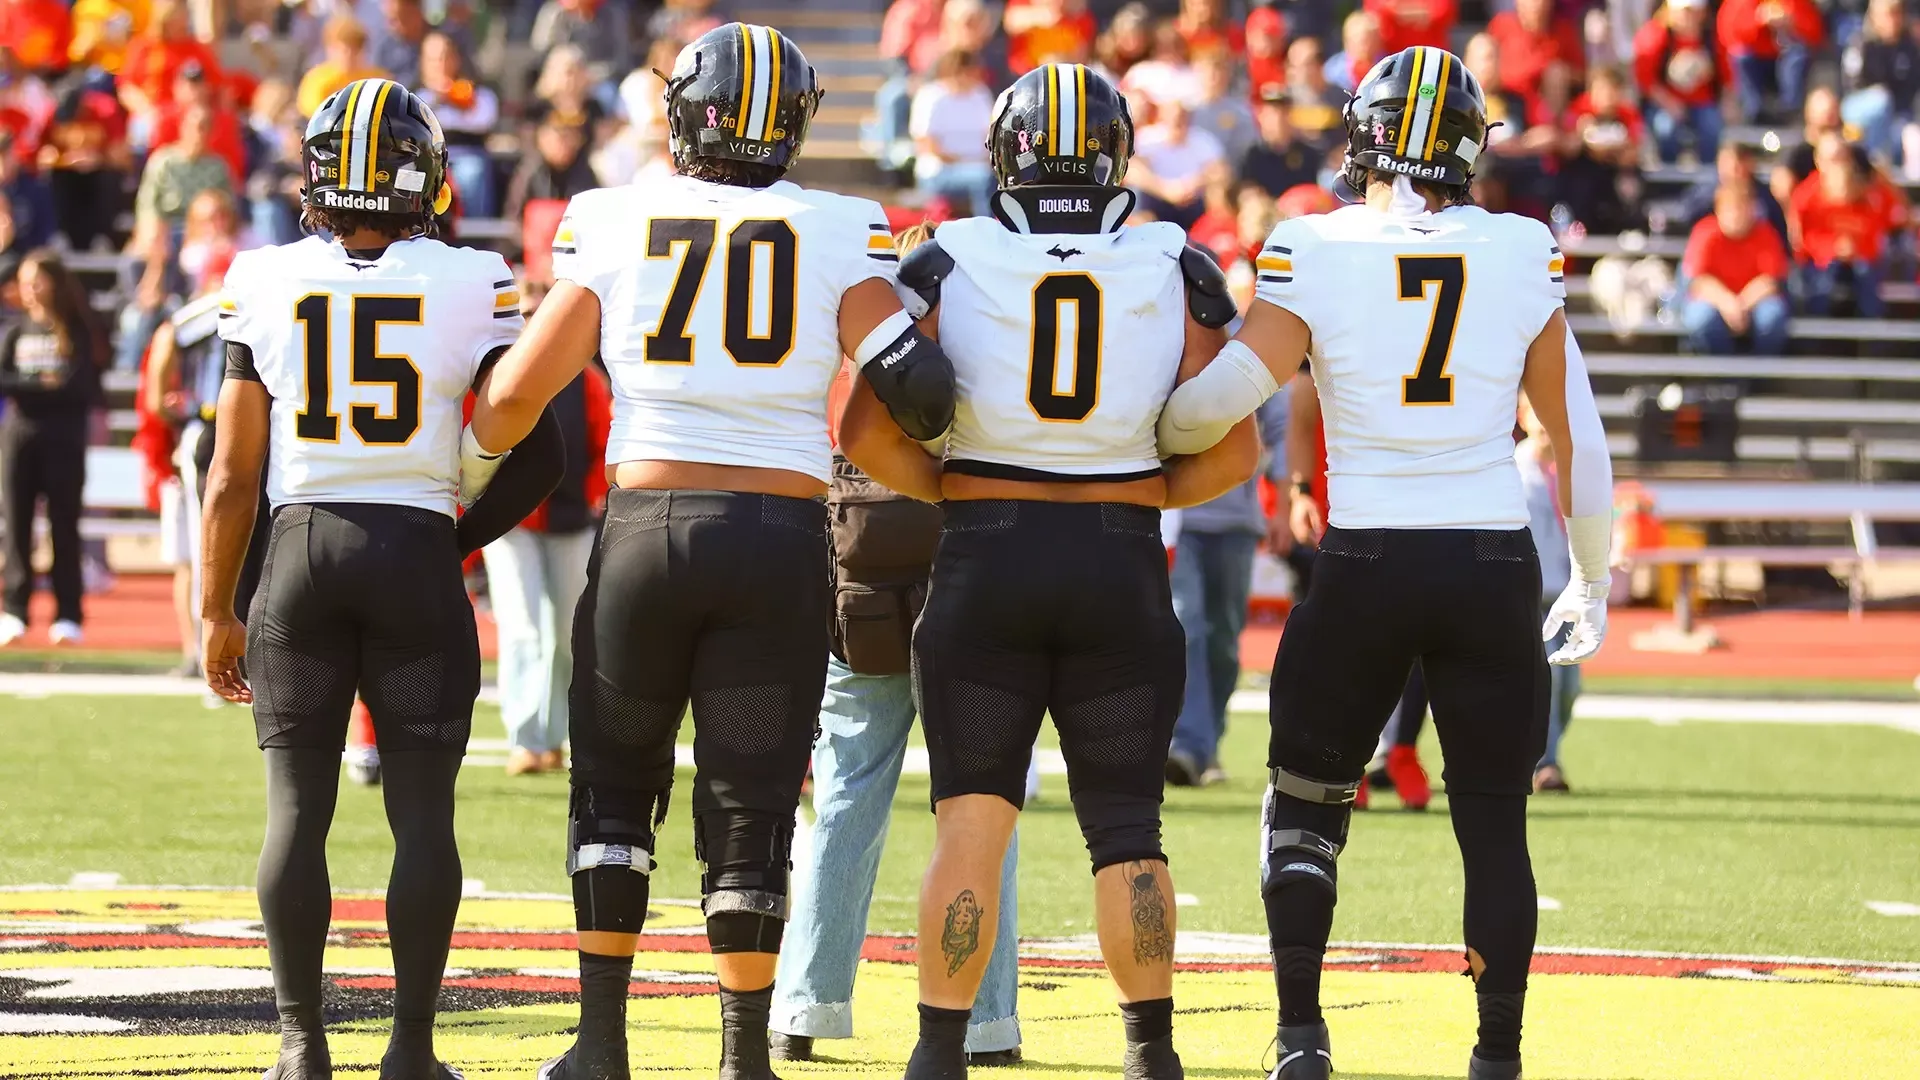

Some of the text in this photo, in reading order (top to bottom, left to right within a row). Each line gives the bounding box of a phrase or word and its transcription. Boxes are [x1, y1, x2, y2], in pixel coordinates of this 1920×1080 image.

[1419, 87, 1435, 95] C2P
[1388, 130, 1395, 141] 7
[729, 142, 772, 158] VICIS
[328, 167, 338, 179] 15
[1043, 161, 1087, 175] VICIS
[1376, 154, 1446, 180] Riddell
[324, 191, 389, 211] Riddell
[644, 217, 799, 368] 70
[1394, 253, 1468, 407] 7
[1026, 271, 1104, 425] 0
[294, 292, 425, 447] 15
